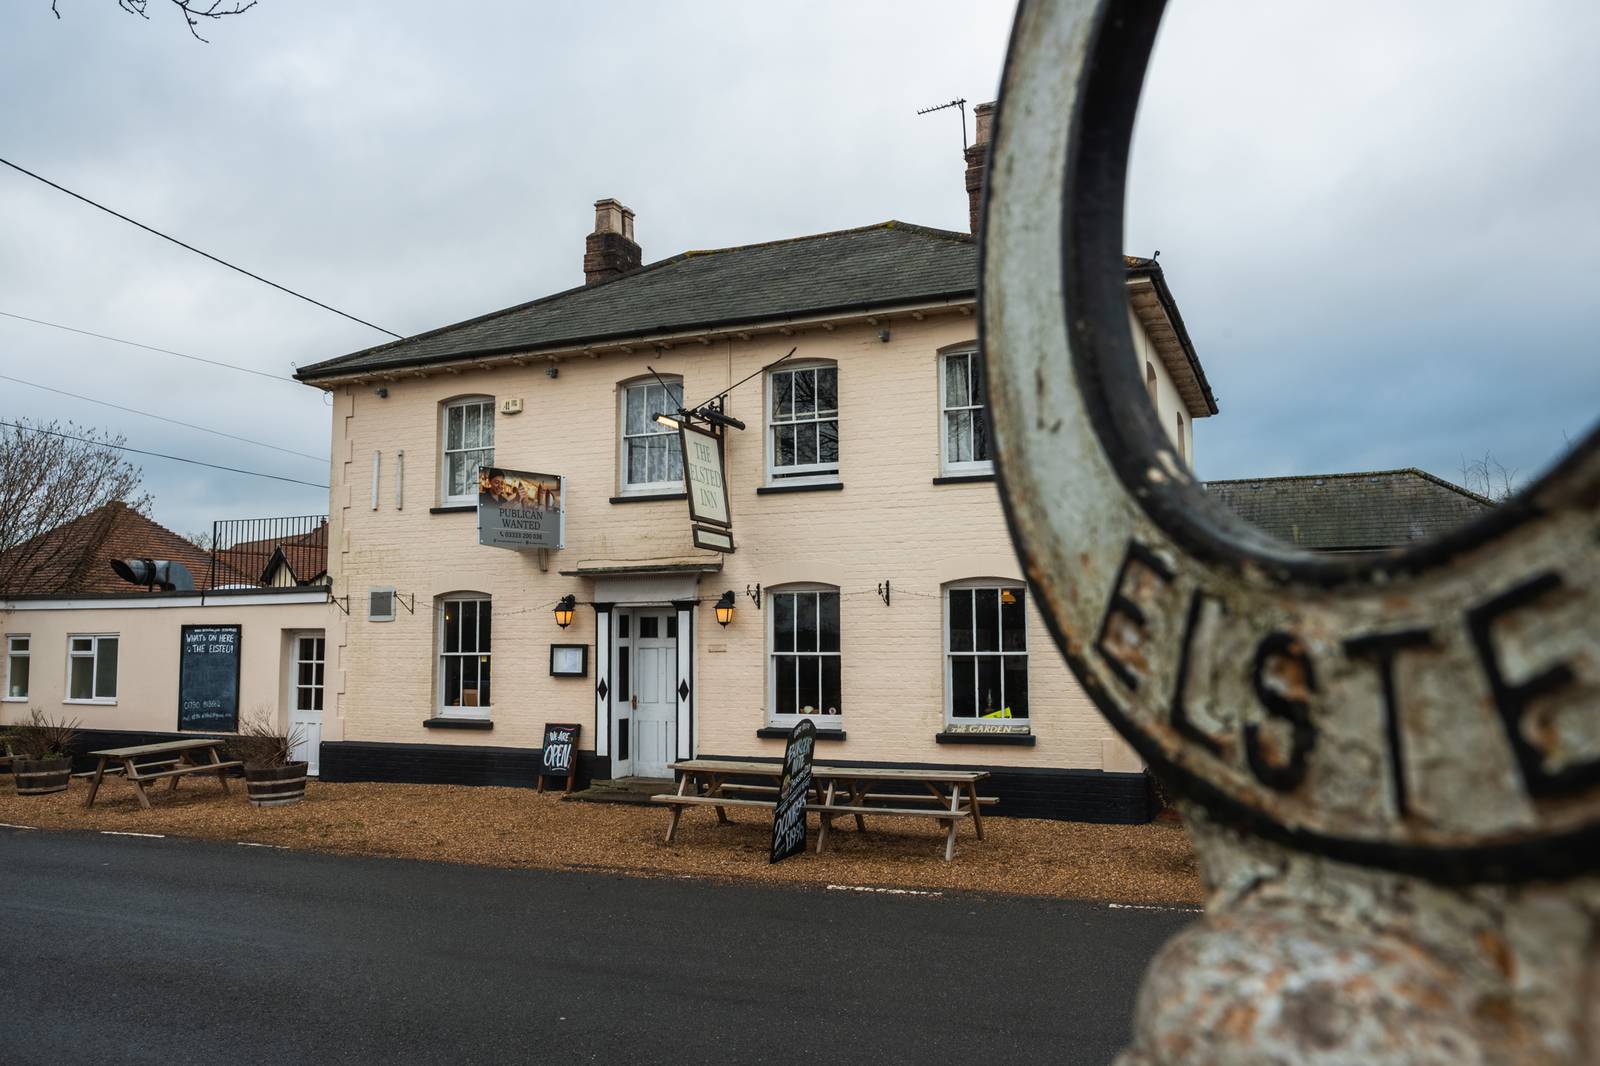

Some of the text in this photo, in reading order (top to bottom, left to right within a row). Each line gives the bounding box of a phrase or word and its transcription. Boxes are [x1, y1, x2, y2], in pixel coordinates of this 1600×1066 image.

[694, 442, 711, 463] THE
[689, 463, 721, 488] ELSTED
[700, 487, 718, 508] INN
[499, 509, 543, 520] PUBLICAN
[502, 518, 541, 530] WANTED
[219, 634, 234, 643] HERE
[192, 644, 206, 653] THE
[550, 731, 571, 742] WE ARE
[544, 744, 571, 768] OPEN
